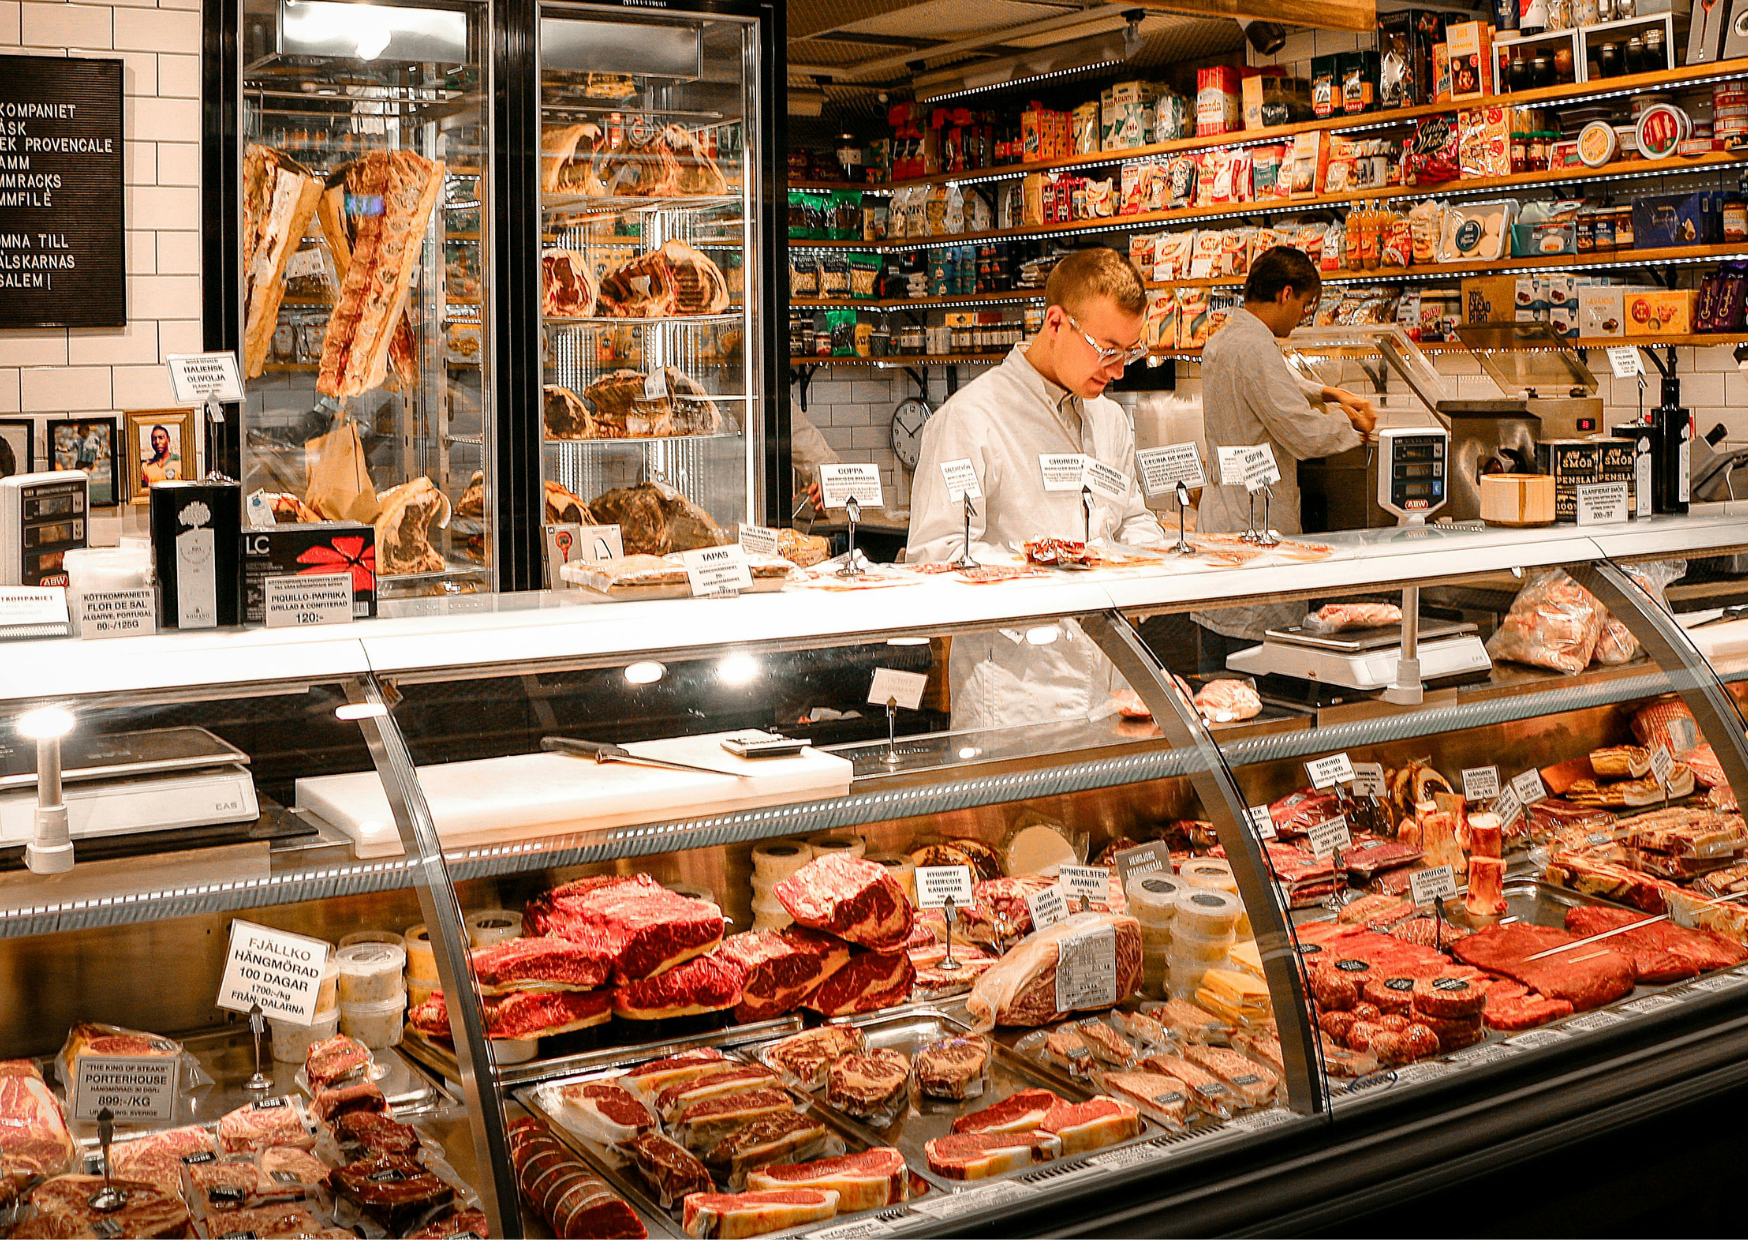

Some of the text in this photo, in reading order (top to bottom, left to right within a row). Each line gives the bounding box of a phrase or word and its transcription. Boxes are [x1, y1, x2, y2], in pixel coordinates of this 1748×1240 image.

[26, 138, 112, 152] PROVENCALE
[38, 234, 70, 248] TILL
[1468, 290, 1484, 300] 70%
[1468, 302, 1491, 313] CACAO
[184, 364, 224, 374] ITALIENSK
[1562, 456, 1592, 468] SMÖR
[246, 535, 270, 554] LC
[702, 551, 728, 561] TAPAS
[44, 576, 66, 586] ABW
[83, 591, 150, 602] KÖTTKOMPANIETS
[271, 592, 347, 603] PIQUILLO-PAPRIKA
[88, 600, 147, 612] FLOR DE SAL
[270, 603, 298, 612] GRILLAD
[306, 601, 348, 610] CONFITERAD
[83, 610, 152, 621] ALGARVE, PORTUGAL
[296, 612, 324, 623] 120:-
[216, 801, 237, 810] CAS
[1060, 867, 1108, 878] SPINDELSTEK
[1417, 866, 1447, 880] ZABUTON
[249, 938, 311, 962] FJÄLLKO
[234, 950, 319, 978] HÄNGMÖRAD
[240, 966, 308, 992] 100 DAGAR
[261, 998, 305, 1015] DALARNA
[86, 1074, 167, 1085] PORTERHOUSE
[98, 1095, 151, 1107] 899:-/KG
